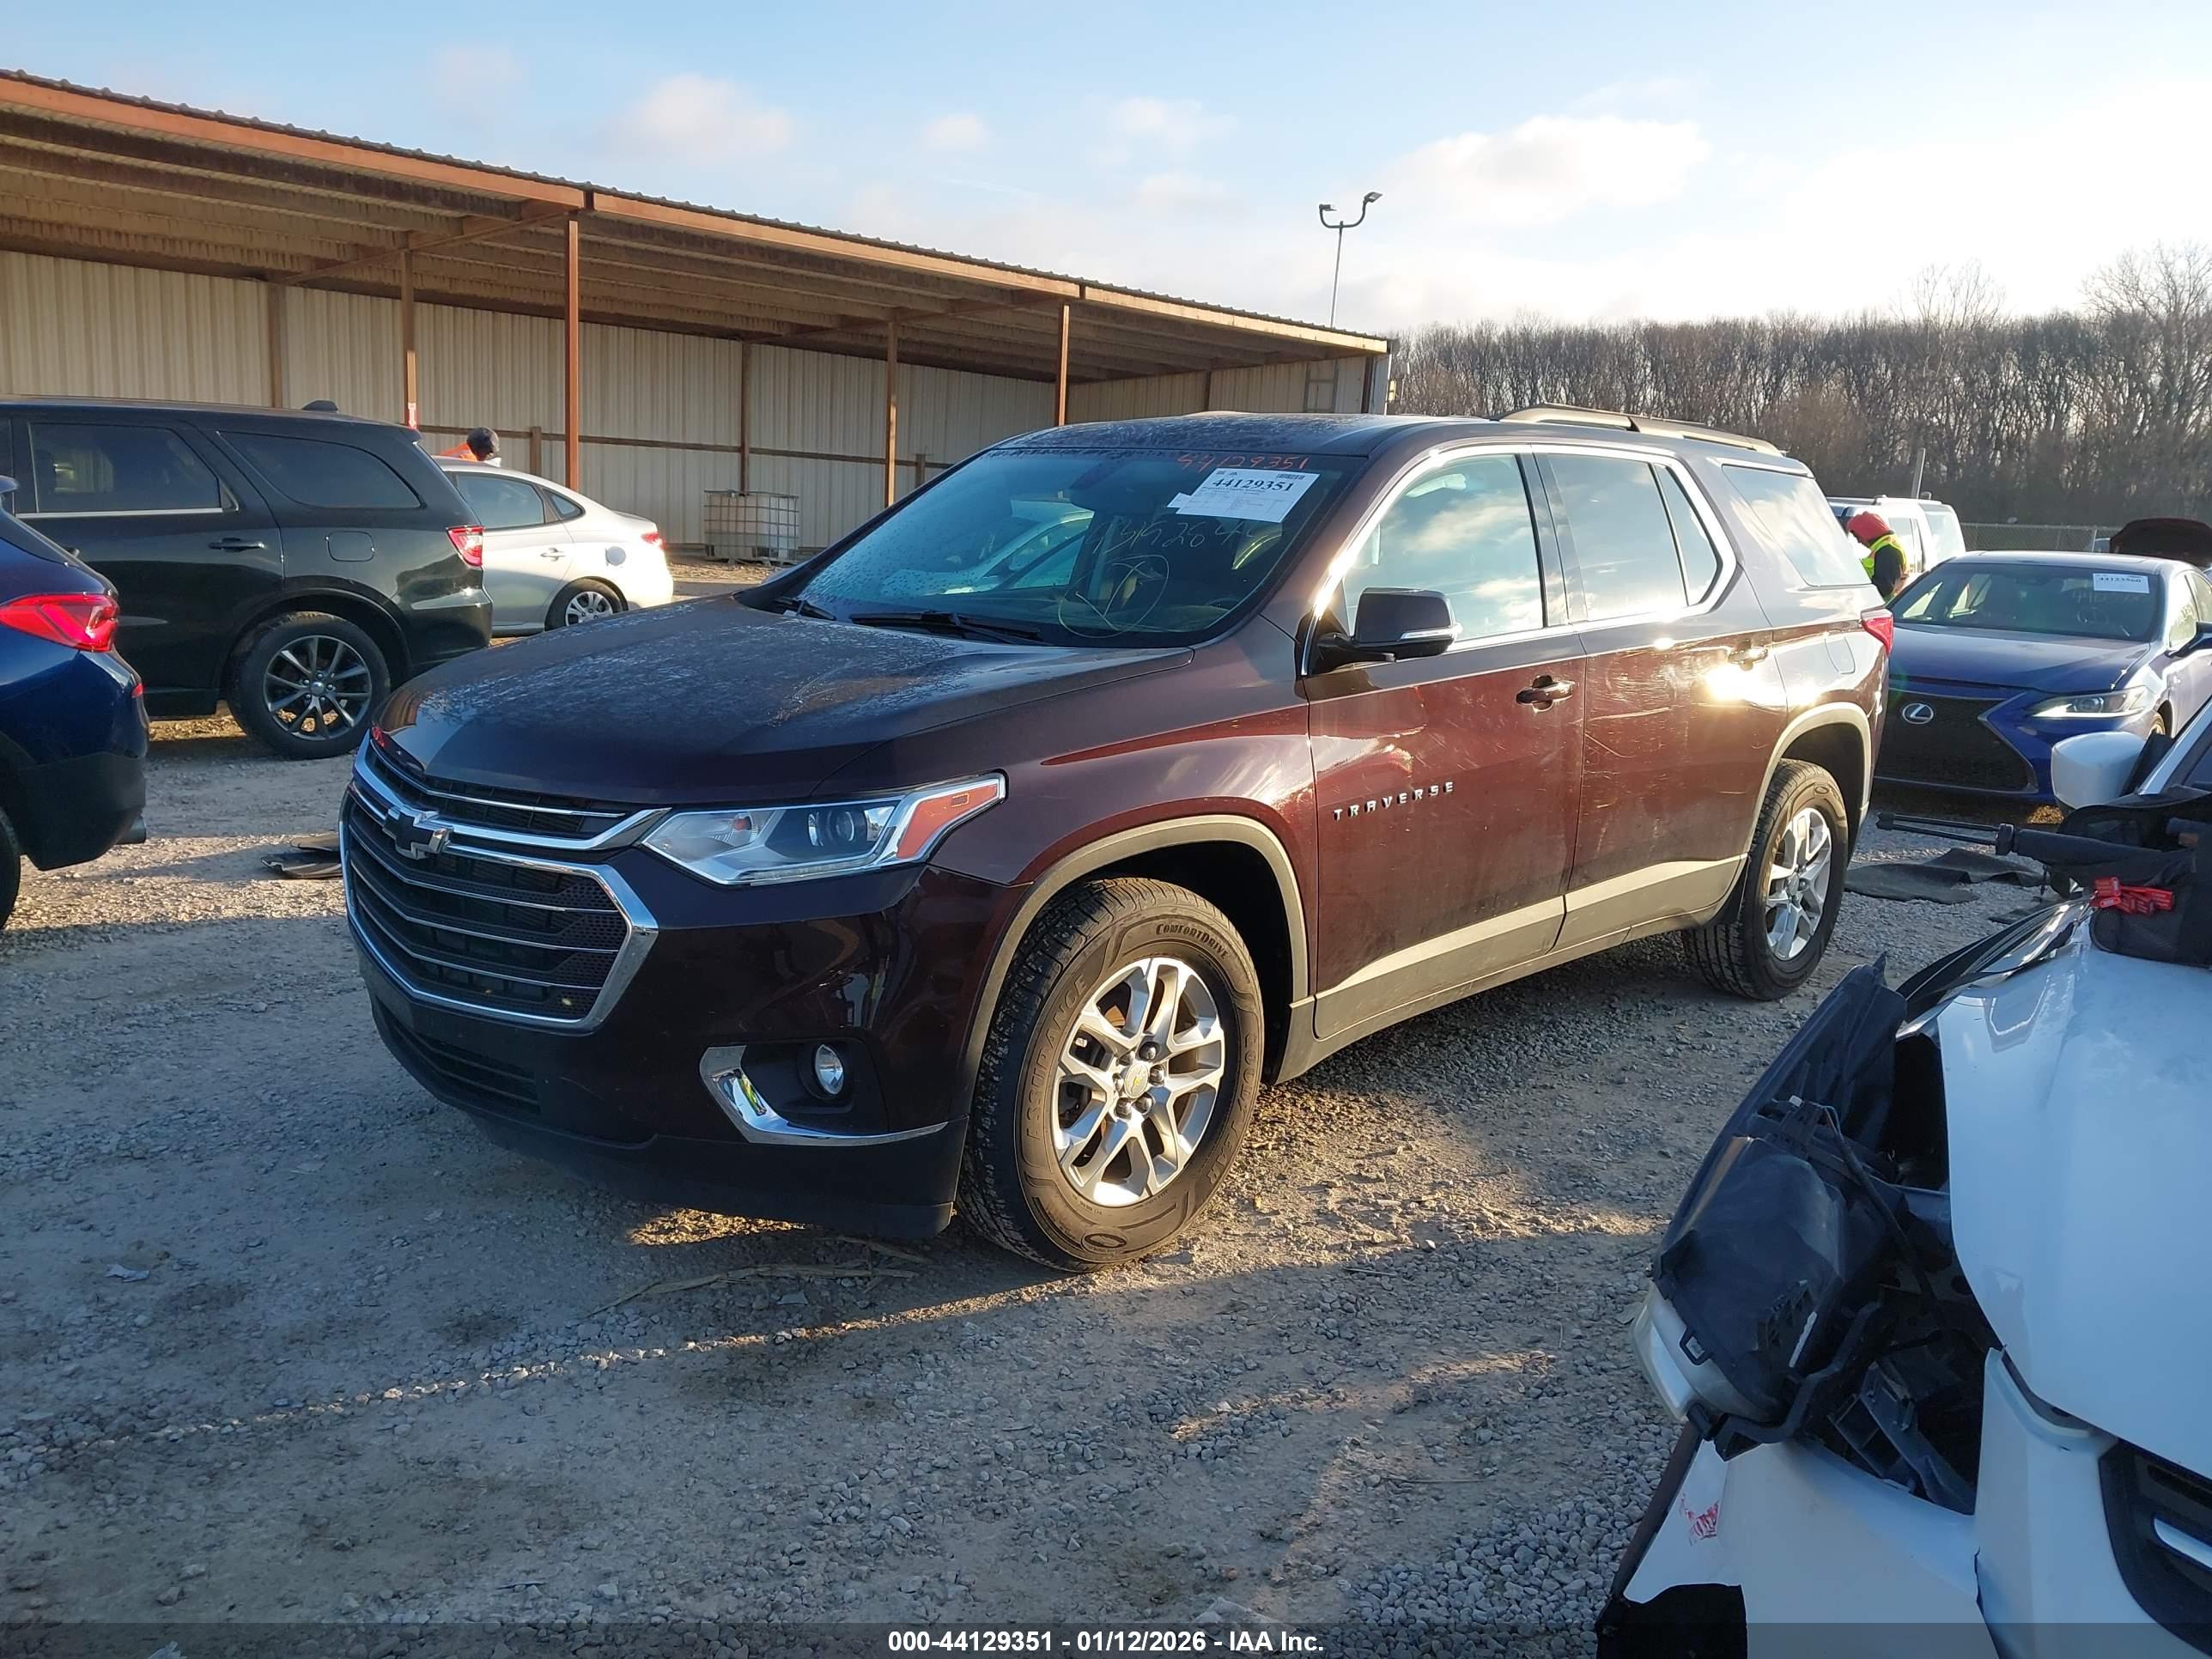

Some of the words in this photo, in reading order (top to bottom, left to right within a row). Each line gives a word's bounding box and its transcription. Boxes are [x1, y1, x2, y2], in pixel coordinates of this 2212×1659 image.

[1212, 477, 1295, 492] 44129351
[1332, 781, 1454, 822] TRAVERSE
[1026, 974, 1087, 1140] ASSURANCE
